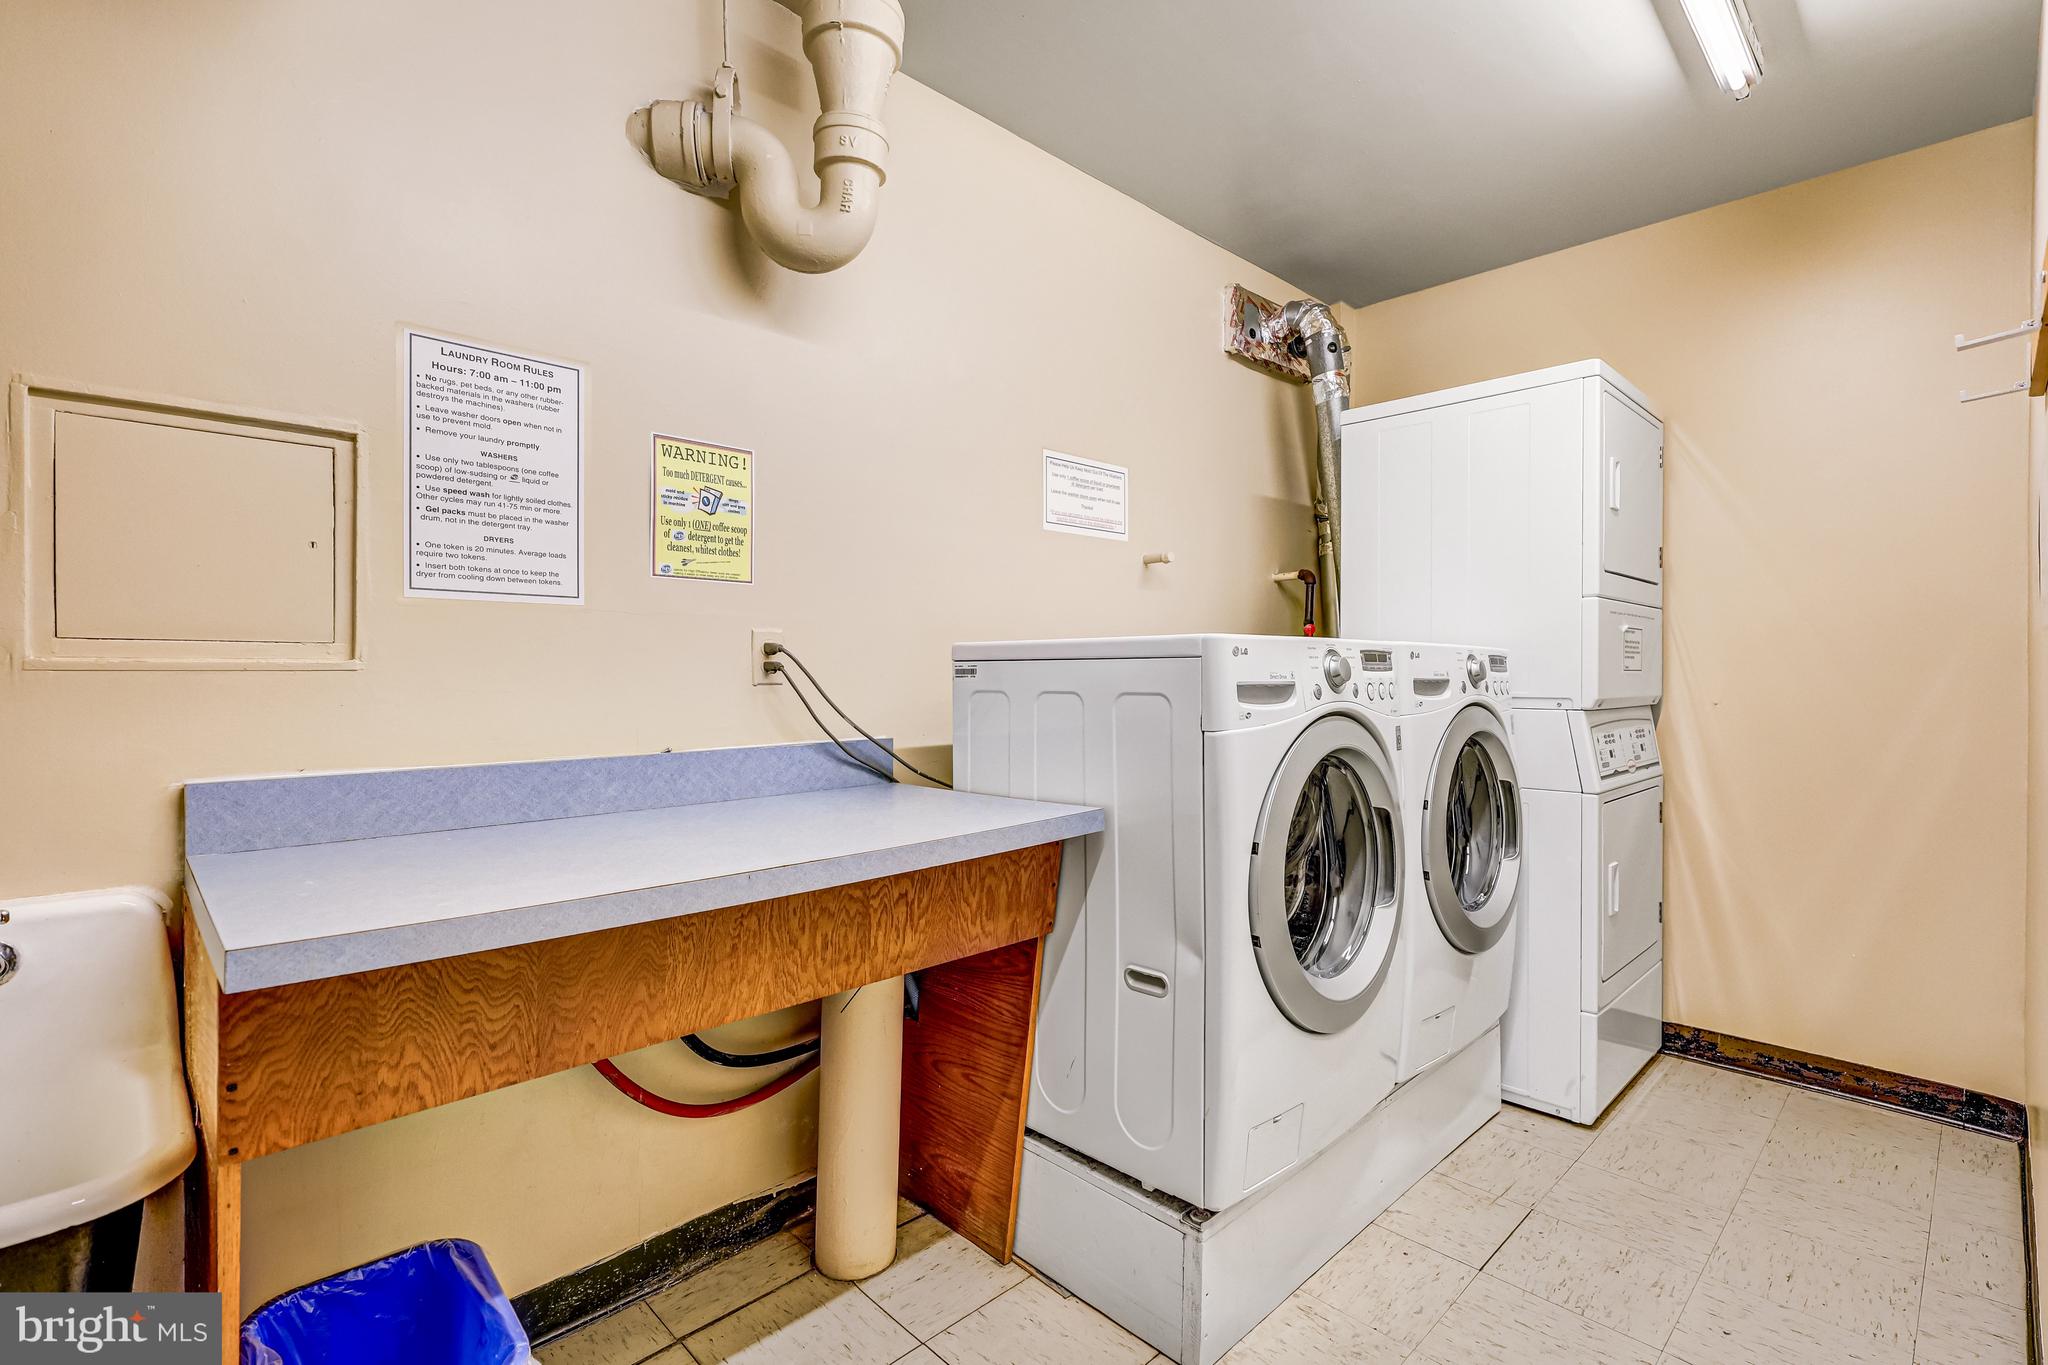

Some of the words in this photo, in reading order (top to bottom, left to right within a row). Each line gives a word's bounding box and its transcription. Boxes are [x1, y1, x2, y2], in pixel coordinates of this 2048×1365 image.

[441, 347, 488, 364] LAUNDRY
[491, 358, 520, 371] ROOM
[523, 364, 554, 378] RULES
[432, 361, 466, 375] Hours:
[470, 369, 491, 380] 7:00
[494, 374, 508, 383] am
[520, 379, 544, 391] 11:00
[547, 385, 561, 394] pm
[416, 381, 444, 392] backed
[447, 387, 480, 398] materials
[492, 394, 502, 402] the
[505, 398, 534, 409] washers
[536, 403, 559, 413] (rubber
[416, 390, 449, 403] destroys
[451, 395, 463, 404] the
[425, 373, 437, 382] No
[461, 381, 473, 389] pet
[506, 389, 518, 398] any
[520, 391, 538, 401] other
[540, 395, 564, 405] rubber-
[416, 412, 430, 421] use
[443, 416, 470, 427] prevent
[425, 404, 448, 415] Leave
[451, 409, 478, 420] washer
[480, 413, 501, 423] doors
[503, 417, 521, 427] open
[523, 420, 542, 430] when
[425, 426, 457, 437] Remove
[460, 431, 476, 441] your
[478, 434, 504, 445] laundry
[425, 453, 440, 462] Use
[443, 455, 458, 465] only
[476, 461, 519, 473] tablespoons
[538, 469, 559, 478] coffee
[481, 451, 518, 461] WASHERS
[661, 444, 746, 470] WARNING!
[416, 464, 442, 473] scoop)
[454, 467, 498, 480] low-sudsing
[522, 477, 540, 486] liquid
[416, 472, 454, 483] powdered
[457, 477, 493, 487] detergent.
[663, 466, 673, 477] Too
[675, 469, 690, 480] much
[691, 472, 725, 485] DETERGENT
[416, 491, 438, 500] Other
[440, 495, 464, 505] cycles
[466, 498, 481, 507] may
[497, 502, 518, 510] 41-75
[425, 484, 440, 492] Use
[443, 487, 467, 496] speed
[470, 490, 490, 498] wash
[504, 494, 523, 503] lightly
[525, 496, 545, 505] soiled
[420, 514, 442, 523] drum,
[468, 518, 479, 526] the
[482, 520, 515, 530] detergent
[517, 523, 532, 532] tray.
[425, 505, 440, 513] Gel
[442, 508, 465, 517] packs
[468, 510, 485, 518] must
[499, 512, 522, 523] placed
[532, 516, 543, 524] the
[545, 519, 569, 527] washer
[661, 516, 672, 525] Use
[674, 518, 687, 528] only
[692, 520, 711, 532] (ONE)
[712, 522, 730, 532] coffee
[731, 525, 747, 535] scoop
[484, 536, 514, 544] DRYERS
[664, 529, 670, 538] of
[688, 532, 716, 544] detergent
[725, 536, 734, 546] get
[735, 536, 744, 545] the
[416, 551, 443, 559] require
[461, 552, 487, 561] tokens.
[425, 541, 442, 549] One
[443, 543, 465, 551] token
[486, 547, 516, 555] minutes.
[518, 550, 547, 558] Average
[548, 551, 567, 559] loads
[667, 542, 694, 553] cleanest,
[695, 544, 717, 555] whitest
[718, 547, 740, 557] clothes!
[416, 571, 436, 579] dryer
[458, 573, 484, 582] cooling
[486, 574, 506, 582] down
[508, 575, 537, 583] between
[425, 562, 447, 570] Insert
[449, 563, 465, 571] both
[467, 565, 492, 573] tokens
